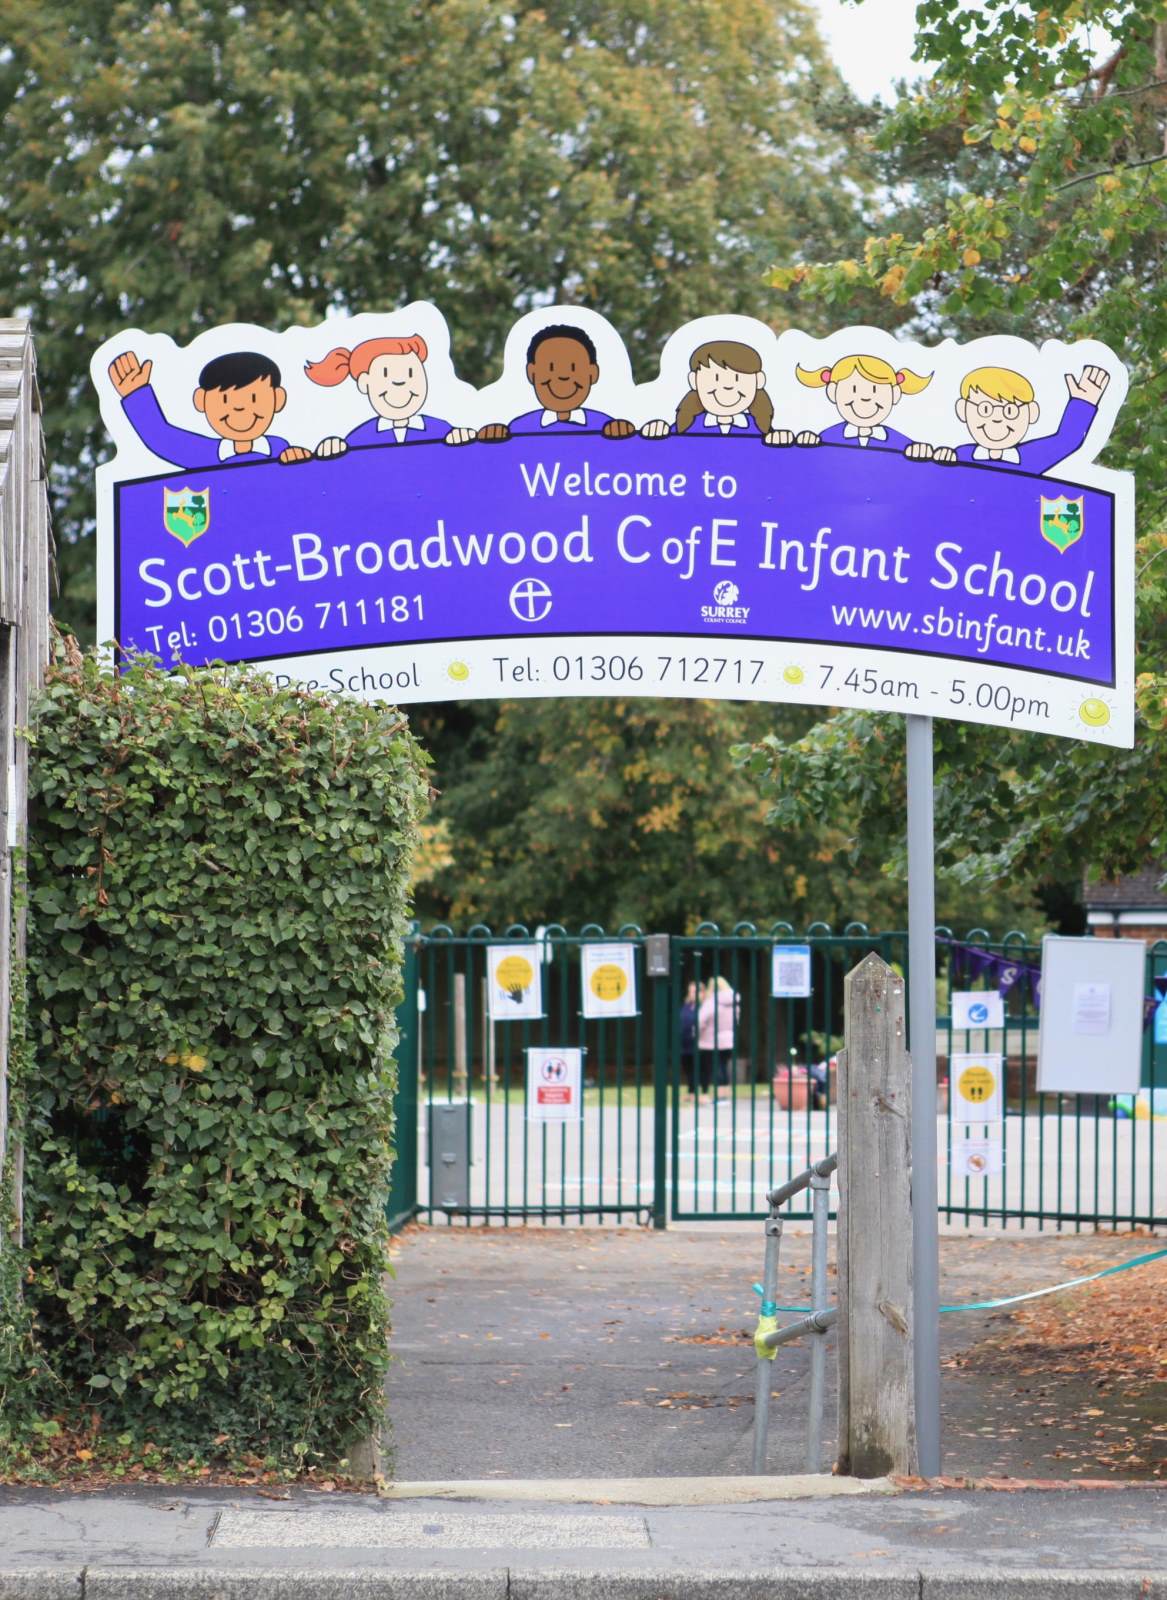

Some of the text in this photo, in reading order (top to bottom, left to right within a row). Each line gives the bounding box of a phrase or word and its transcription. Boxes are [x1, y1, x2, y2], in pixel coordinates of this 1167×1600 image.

[519, 461, 738, 499] Welcome to
[138, 514, 594, 608] Scott-Broadwood
[616, 514, 652, 565] C
[710, 518, 738, 567] E
[758, 521, 911, 592] Infant
[929, 541, 1095, 618] School
[145, 594, 425, 653] Tel: 01306 711181
[700, 605, 751, 619] SURREY
[831, 604, 1092, 662] www.sbinfant.uk
[493, 657, 540, 683] Tel:
[553, 655, 643, 682] 01306
[658, 656, 764, 685] 712717
[820, 665, 919, 700] 7.45am
[949, 679, 1050, 722] 5.00pm
